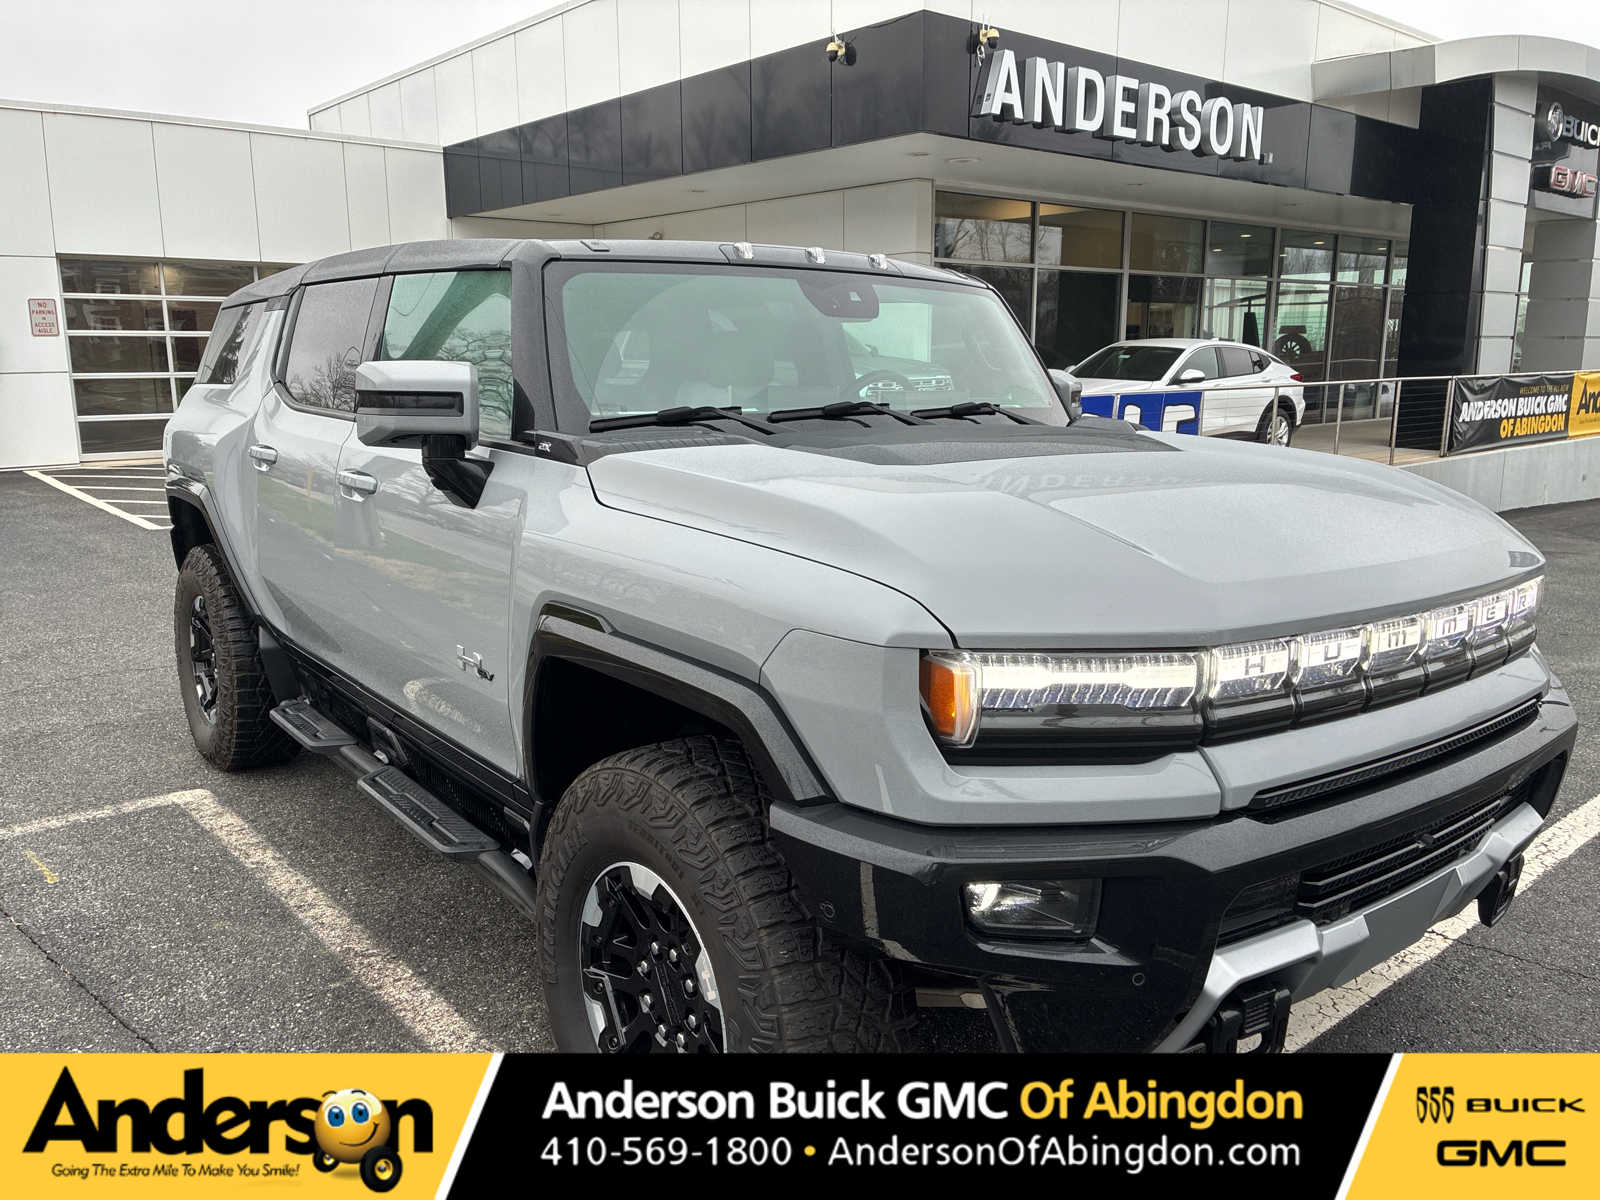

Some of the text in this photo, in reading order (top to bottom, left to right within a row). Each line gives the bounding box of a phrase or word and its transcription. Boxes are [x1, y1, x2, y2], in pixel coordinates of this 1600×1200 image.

[982, 49, 1264, 160] ANDERSON
[1551, 166, 1597, 195] GMC
[1459, 394, 1568, 422] ANDERSON BUICK GMC
[1500, 413, 1565, 439] OF ABINGDON
[1244, 591, 1531, 676] HUMMER
